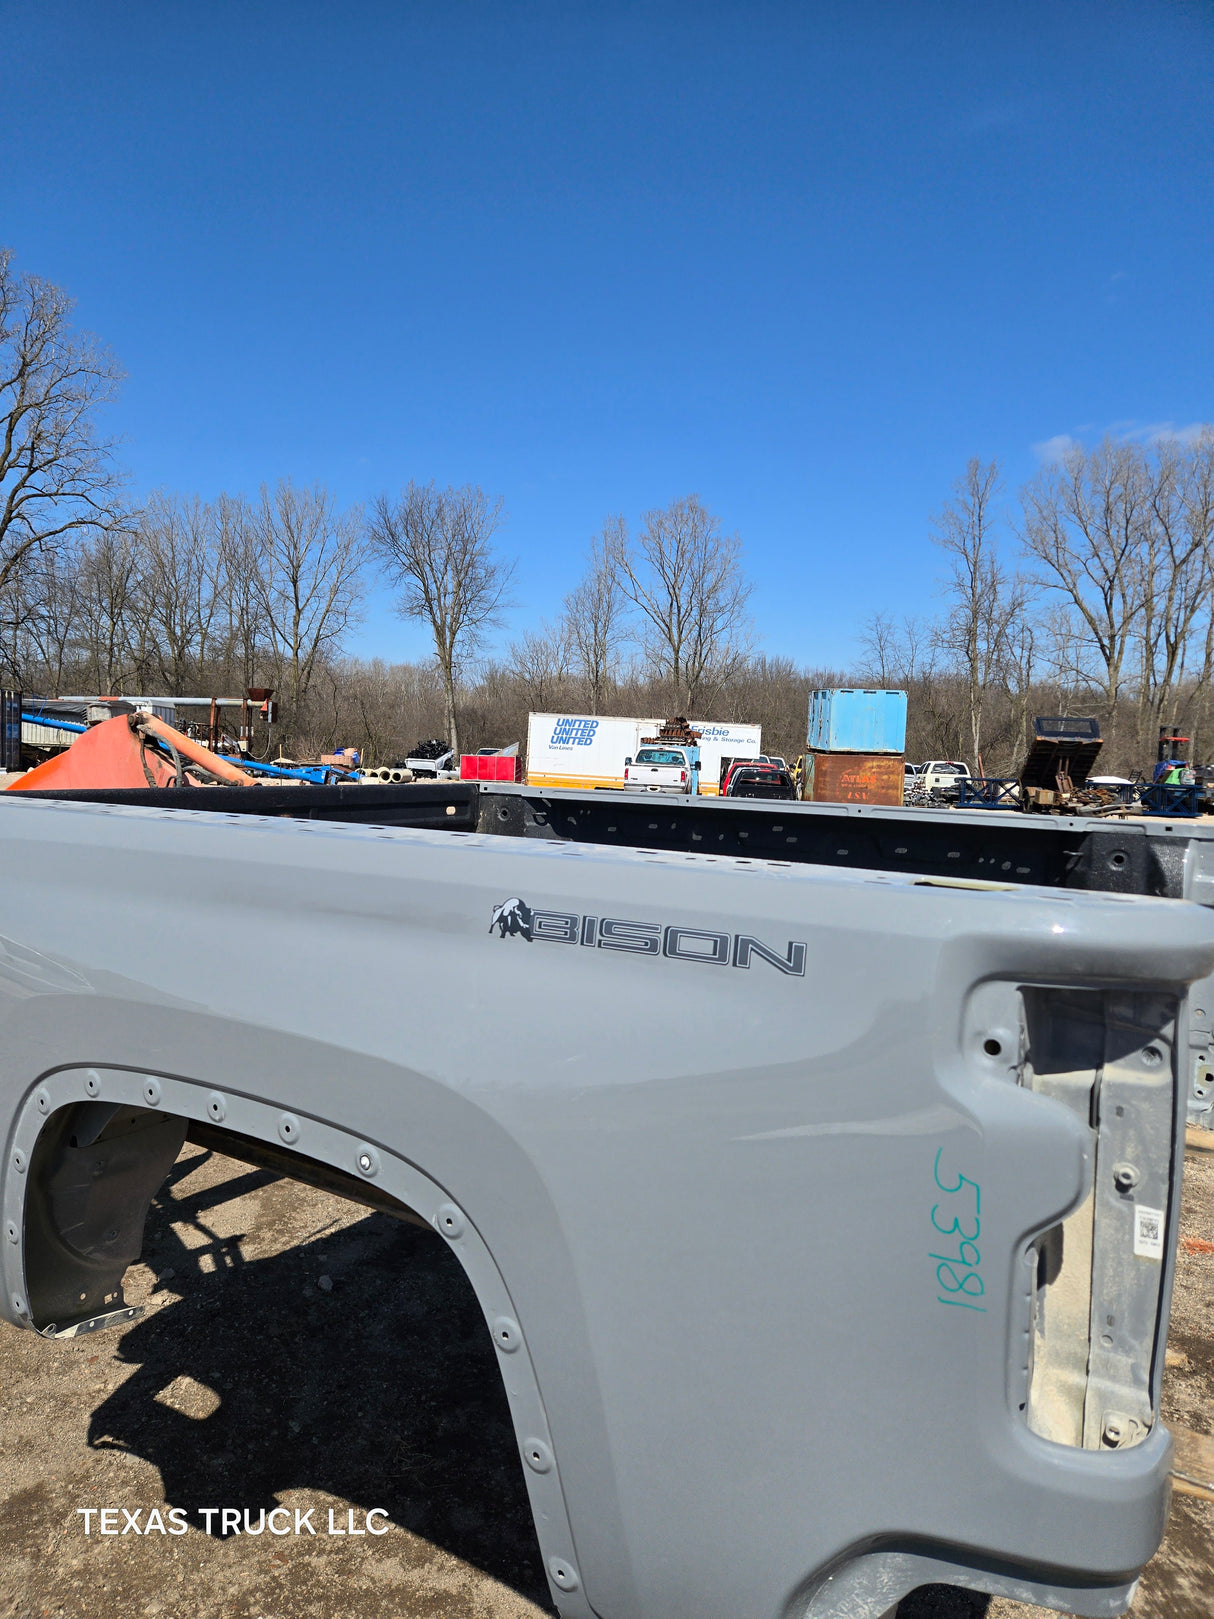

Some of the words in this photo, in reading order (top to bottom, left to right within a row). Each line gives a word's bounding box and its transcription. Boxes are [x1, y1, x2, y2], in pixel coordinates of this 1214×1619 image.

[556, 718, 599, 729] UNITED
[553, 726, 596, 738] UNITED
[691, 725, 730, 736] Frisbie
[550, 735, 593, 746] UNITED
[841, 774, 877, 784] ATLAS
[530, 909, 808, 977] BISON
[928, 1147, 987, 1312] 53981
